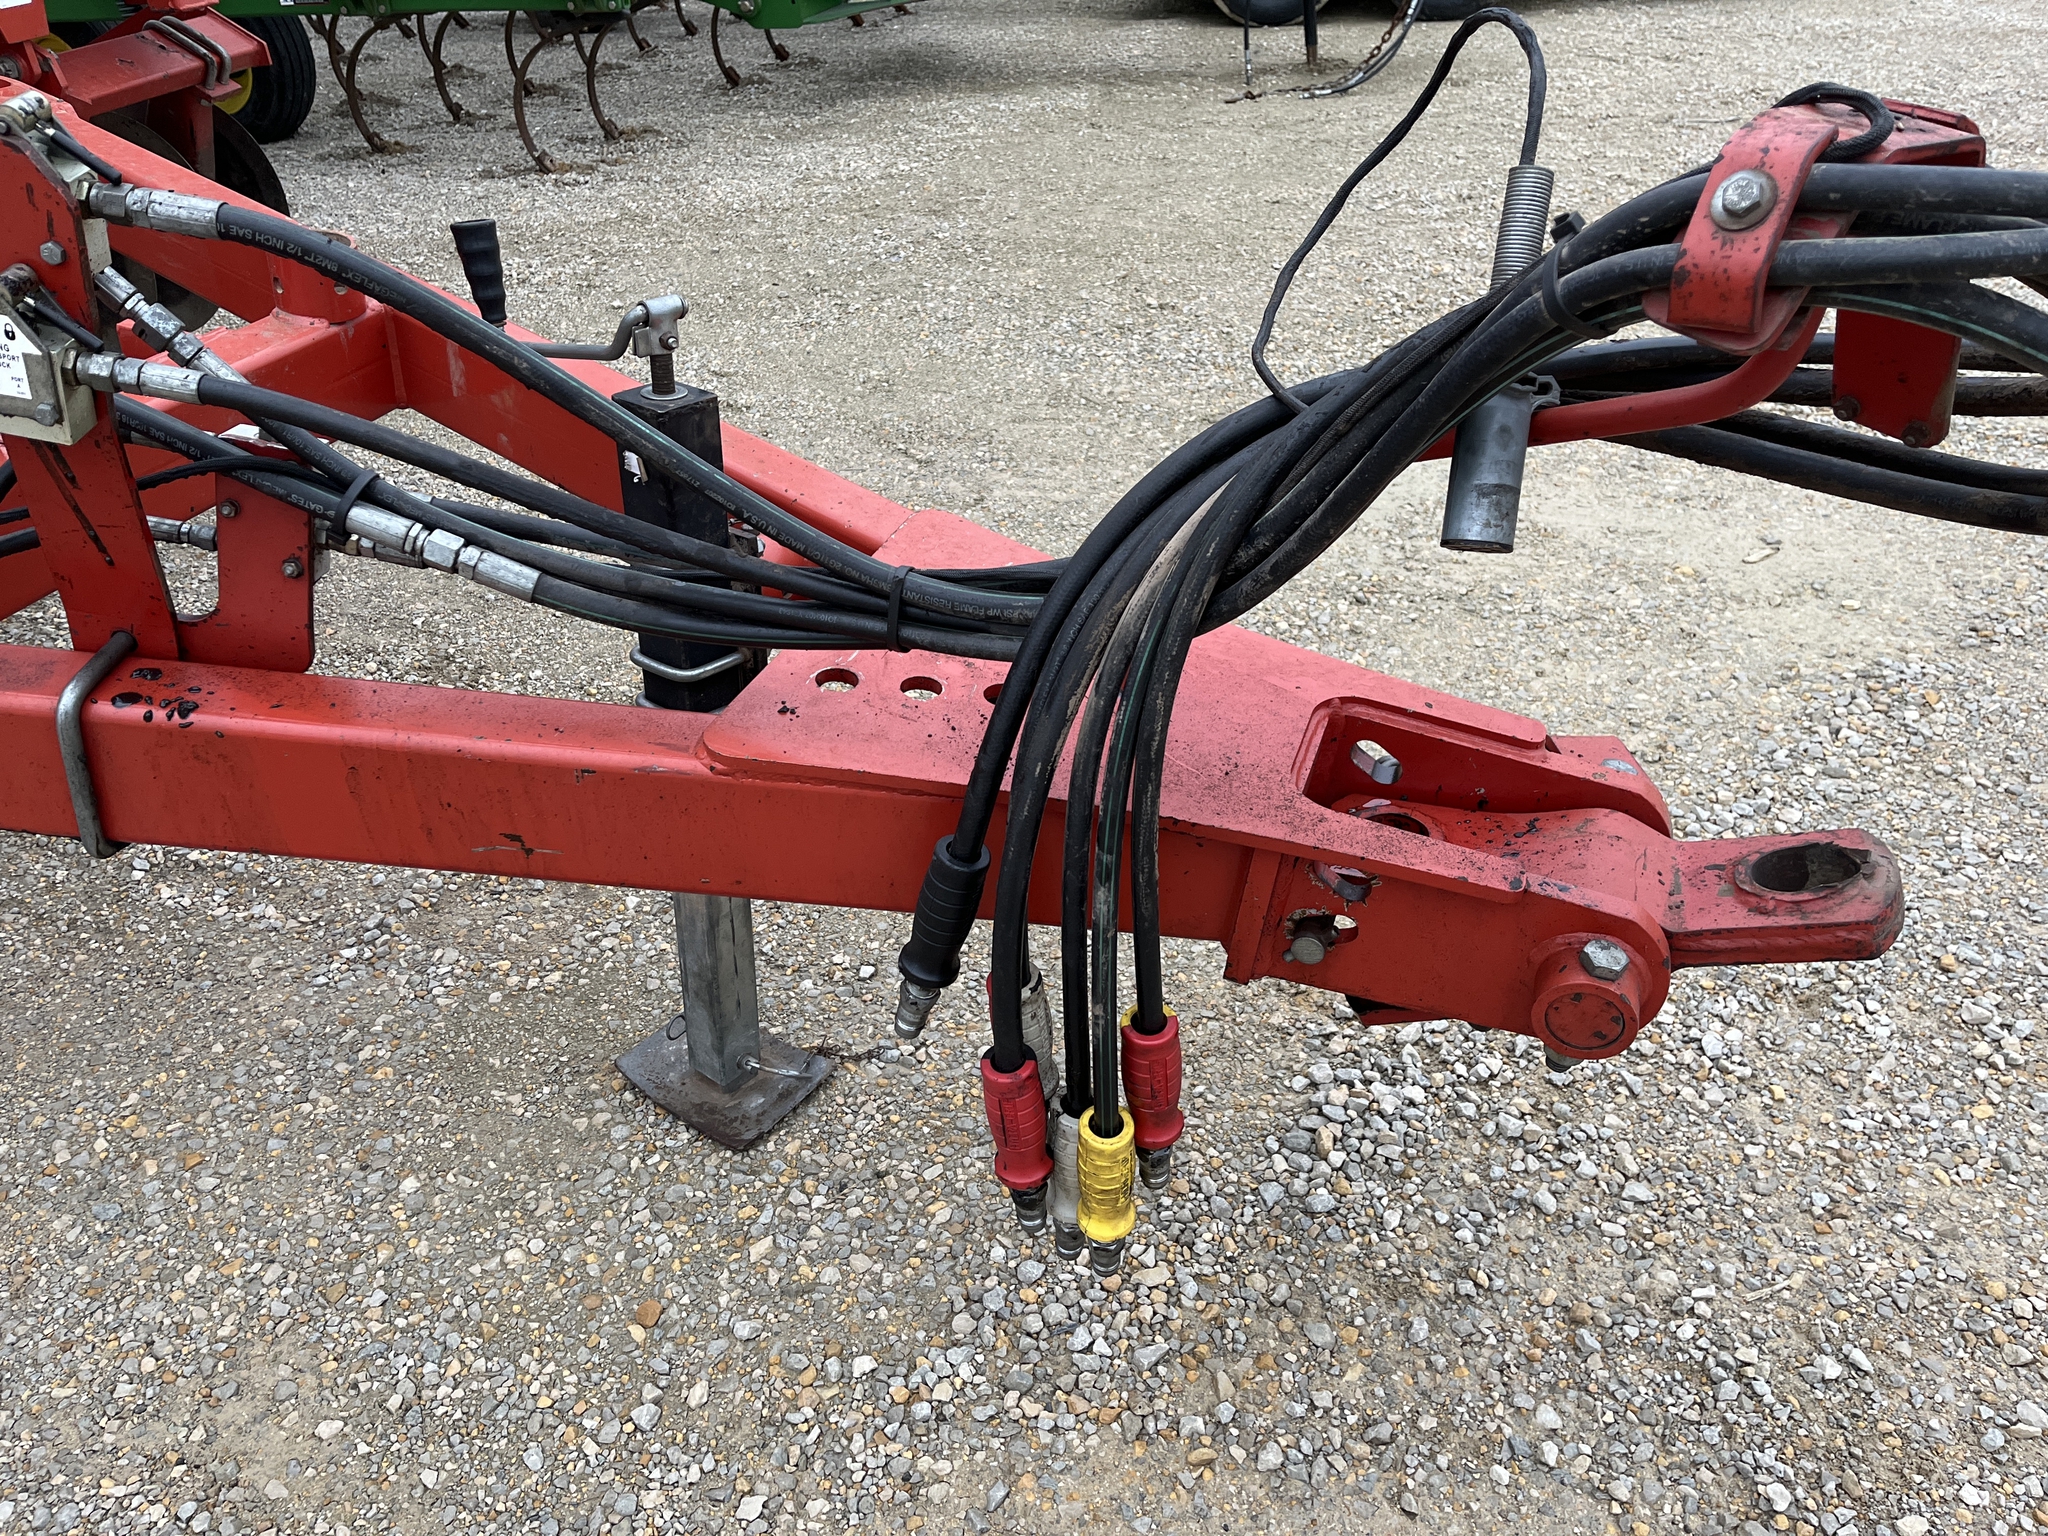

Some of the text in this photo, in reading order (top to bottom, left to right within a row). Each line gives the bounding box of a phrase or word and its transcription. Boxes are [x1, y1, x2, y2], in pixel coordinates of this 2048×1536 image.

[227, 224, 252, 238] SAE
[253, 231, 285, 249] INCH
[285, 242, 303, 256] 1/2
[147, 426, 166, 440] SAE
[164, 434, 188, 451] INCH
[187, 445, 202, 456] 1/2
[303, 443, 322, 460] SAE
[766, 524, 778, 536] IN
[777, 530, 805, 552] MADE
[900, 589, 952, 608] RESISTANT
[953, 601, 985, 615] FLAME
[986, 606, 1002, 617] WP
